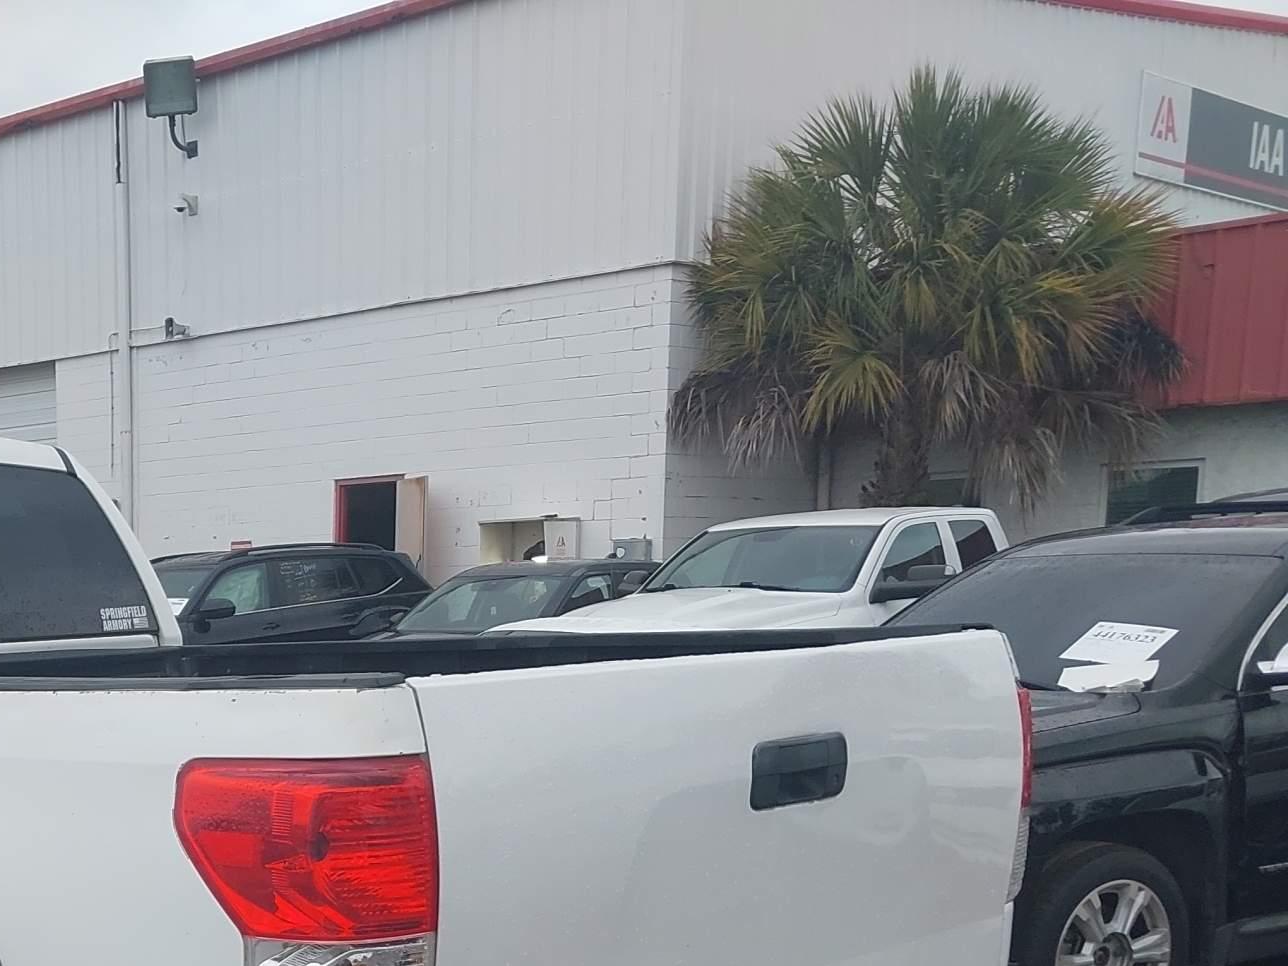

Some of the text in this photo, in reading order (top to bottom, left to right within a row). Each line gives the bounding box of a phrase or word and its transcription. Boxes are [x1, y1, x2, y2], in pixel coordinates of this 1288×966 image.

[1249, 121, 1285, 177] IAA
[100, 605, 147, 620] SPRINGFIELD
[102, 618, 133, 632] ARMORY
